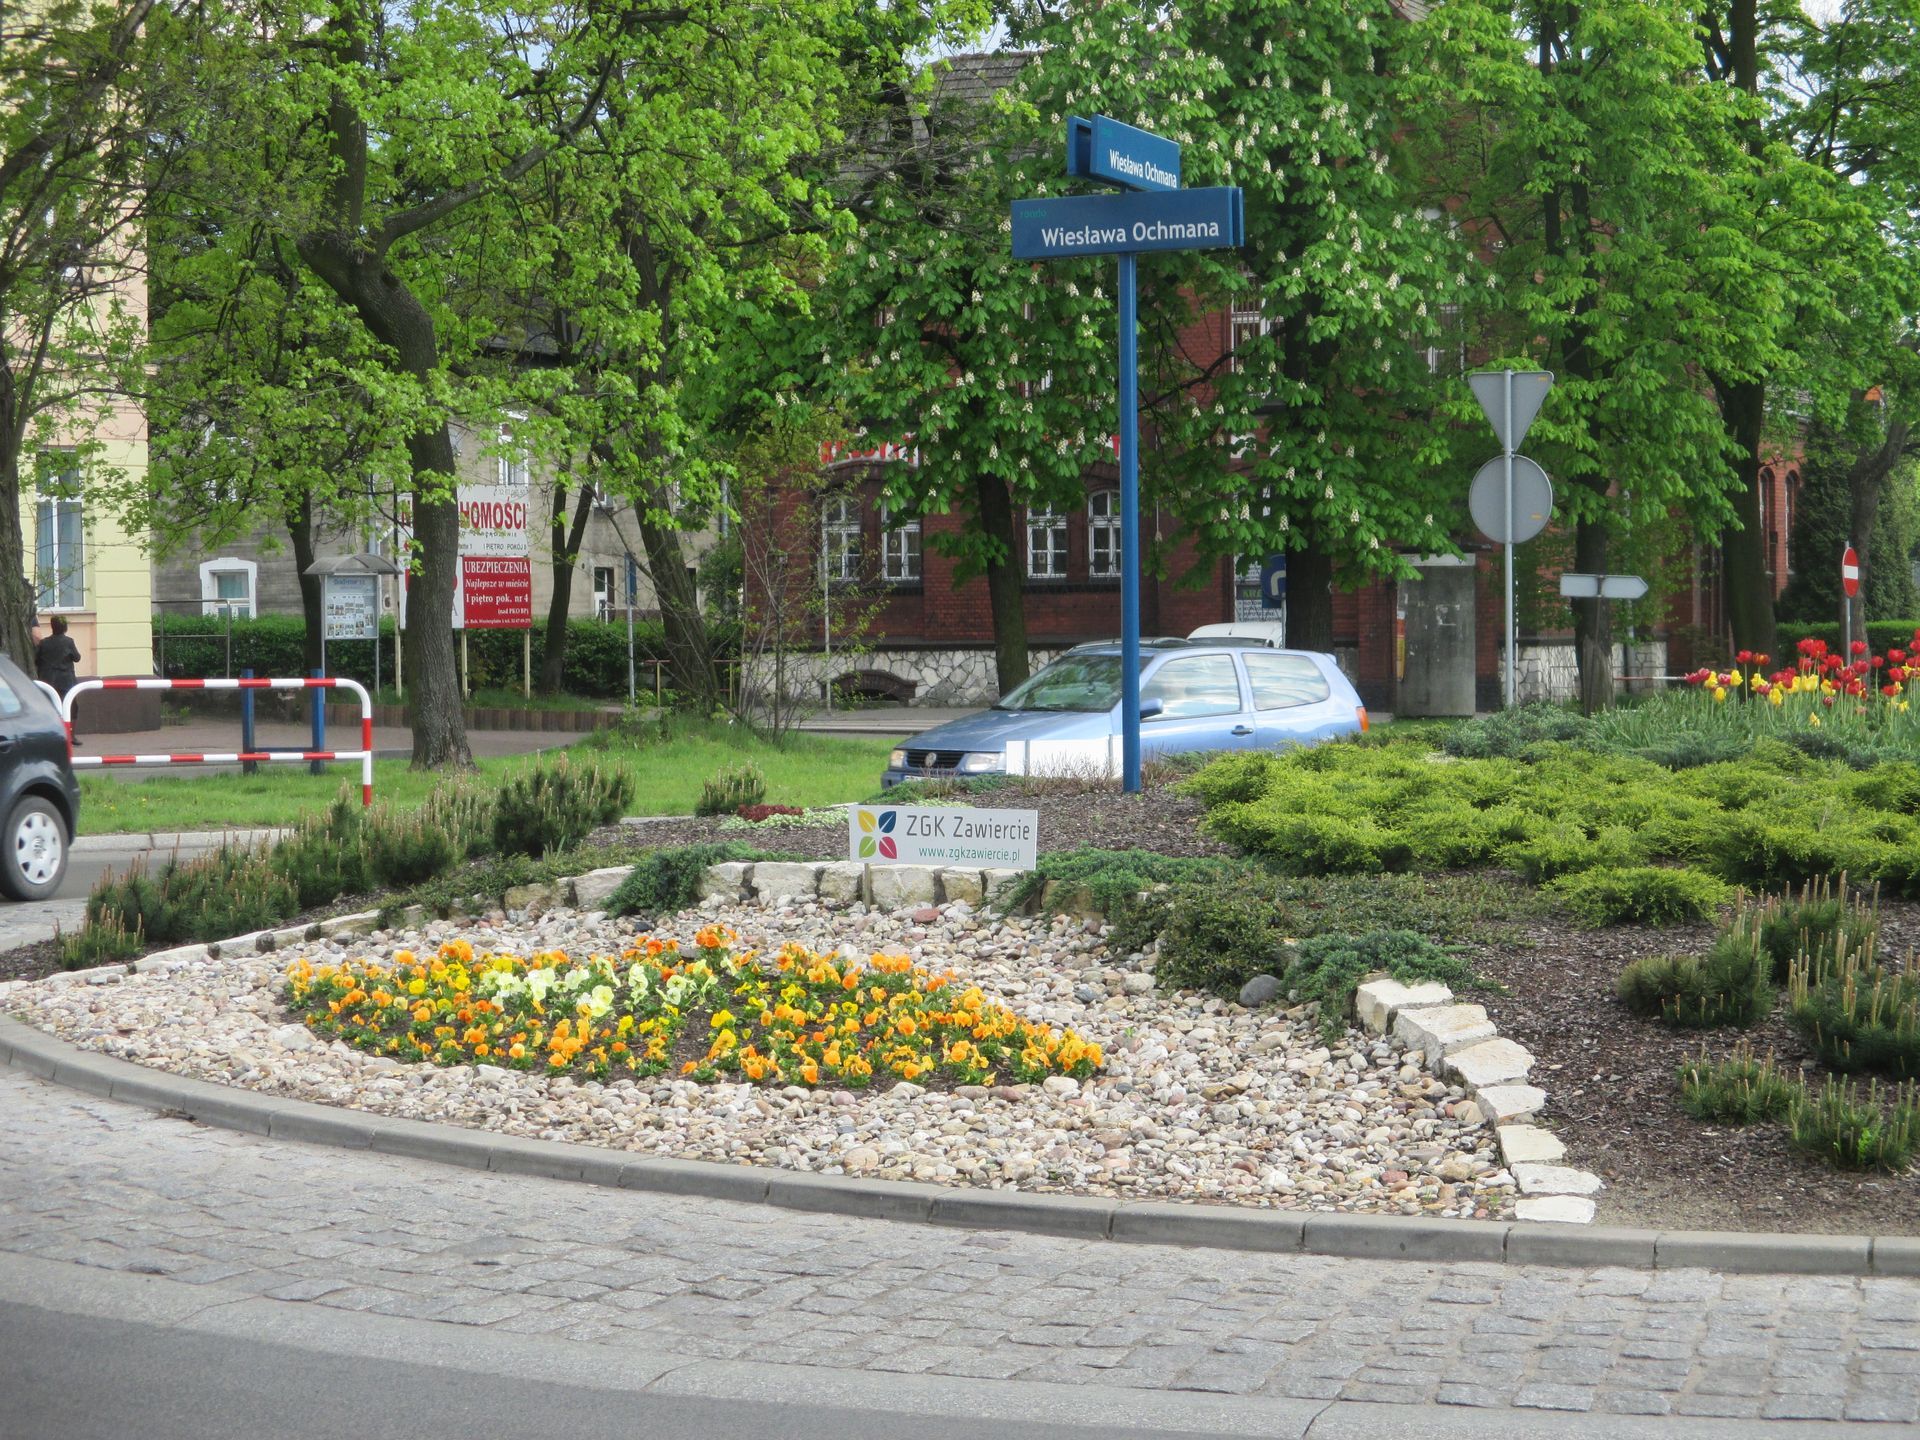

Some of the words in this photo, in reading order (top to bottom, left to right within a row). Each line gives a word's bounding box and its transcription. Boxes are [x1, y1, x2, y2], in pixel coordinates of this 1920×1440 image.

[1109, 149, 1143, 176] Wiesława
[1145, 161, 1177, 188] Ochmana
[1041, 224, 1127, 247] Wiesława
[1132, 220, 1219, 242] Ochmana
[464, 561, 529, 573] UBEZPIECZENIA
[465, 578, 497, 590] Najlepsze
[498, 580, 505, 588] w
[505, 578, 529, 588] mieście
[471, 593, 493, 605] piętro
[495, 593, 512, 605] pok.
[514, 595, 522, 603] nr
[523, 593, 529, 603] 4
[906, 815, 945, 837] ZGK
[953, 816, 1030, 841] Zawiercie
[919, 846, 1020, 863] www.zgkzawiercie.pl
